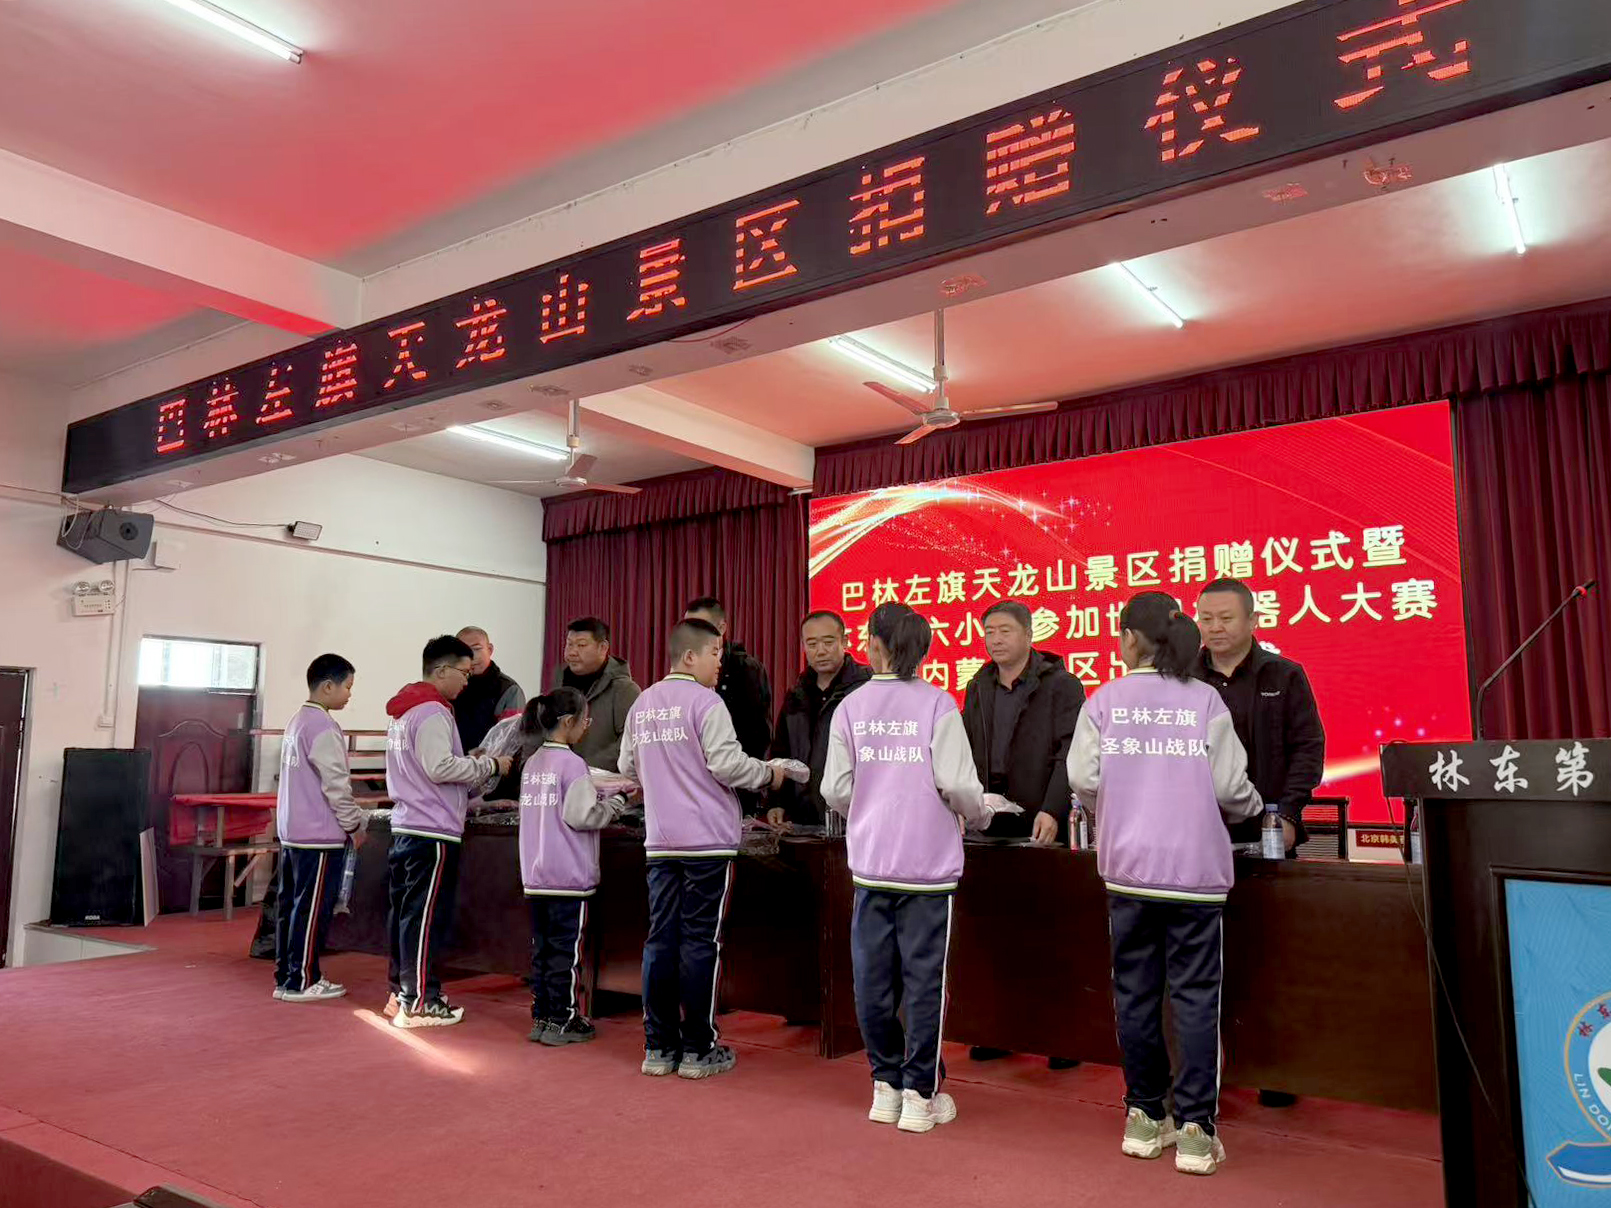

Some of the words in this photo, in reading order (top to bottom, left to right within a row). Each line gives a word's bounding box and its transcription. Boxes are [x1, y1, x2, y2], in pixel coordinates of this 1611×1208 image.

[842, 525, 1406, 612] 巴林左旗天龙山景区捐赠仪式暨
[635, 706, 681, 725] 巴林左旗
[1111, 707, 1197, 726] 巴林左旗
[853, 720, 919, 736] 巴林左旗
[858, 746, 924, 762] 象山战队
[1101, 737, 1208, 757] 圣象山战队
[1429, 741, 1594, 796] 林东第
[1574, 1073, 1591, 1098] LIN
[1589, 1104, 1611, 1131] DO
